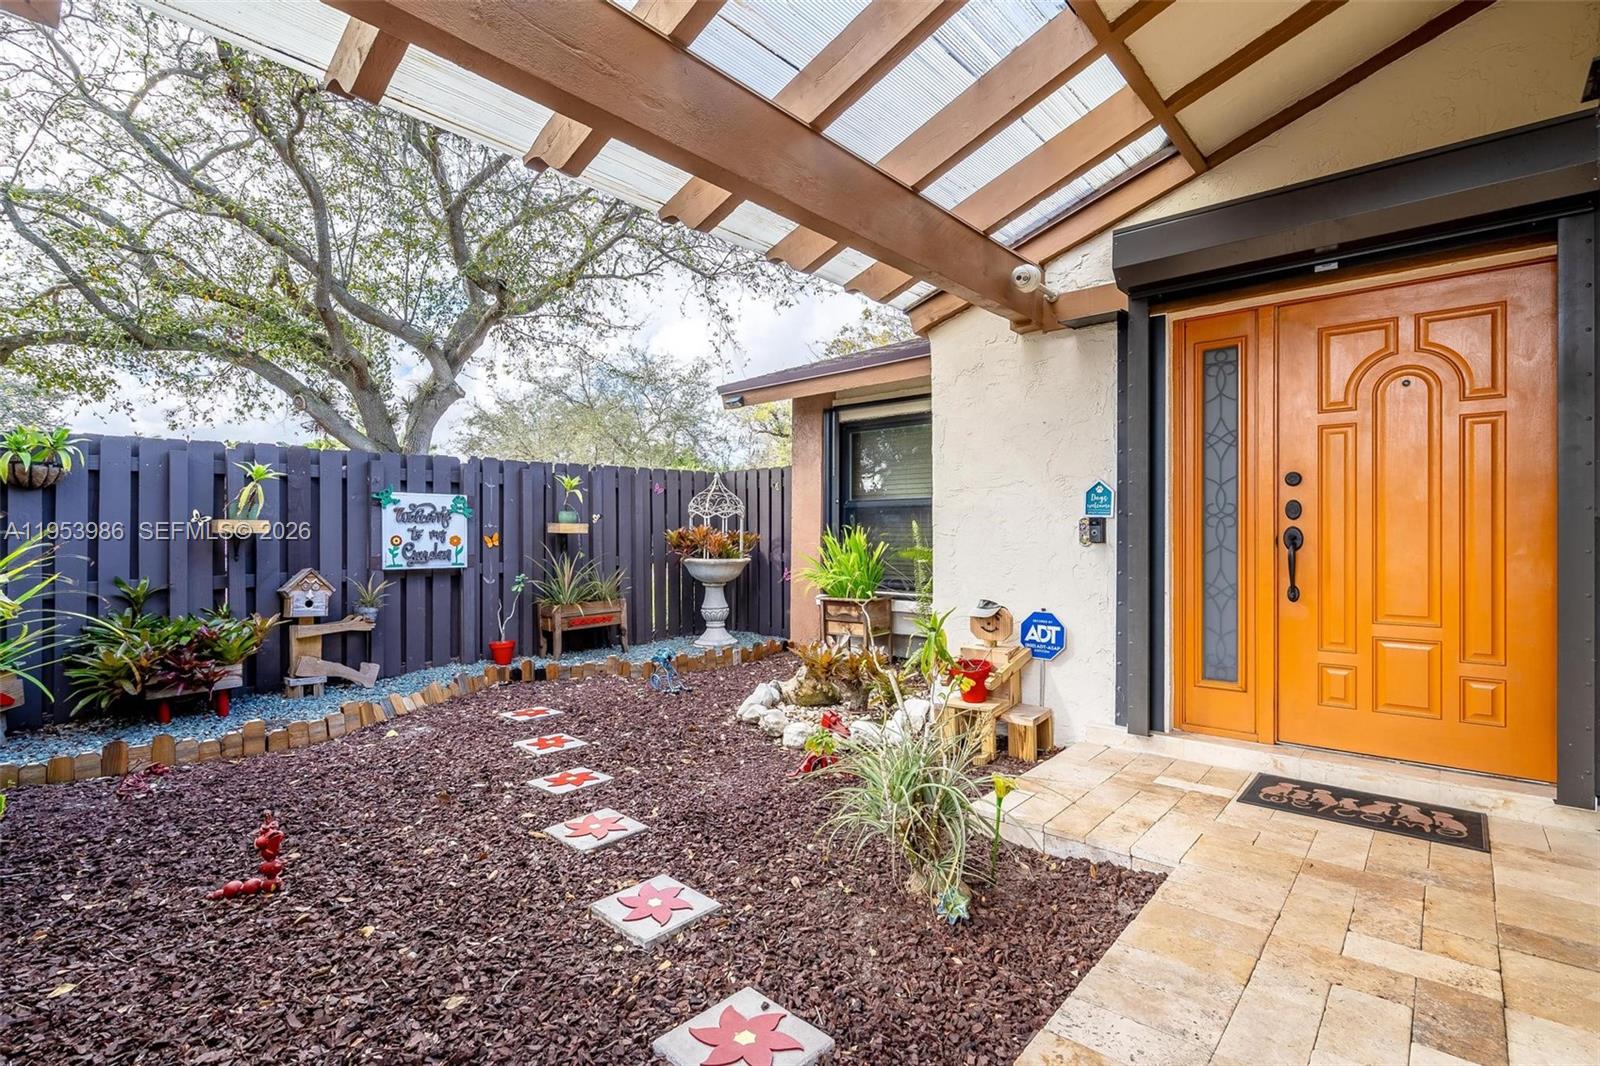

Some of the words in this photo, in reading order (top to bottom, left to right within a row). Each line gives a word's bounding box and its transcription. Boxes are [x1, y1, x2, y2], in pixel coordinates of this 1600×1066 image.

[393, 502, 452, 528] Welcome
[407, 525, 424, 541] to
[428, 529, 447, 543] my
[401, 541, 451, 567] Garden
[1024, 624, 1061, 644] ADT
